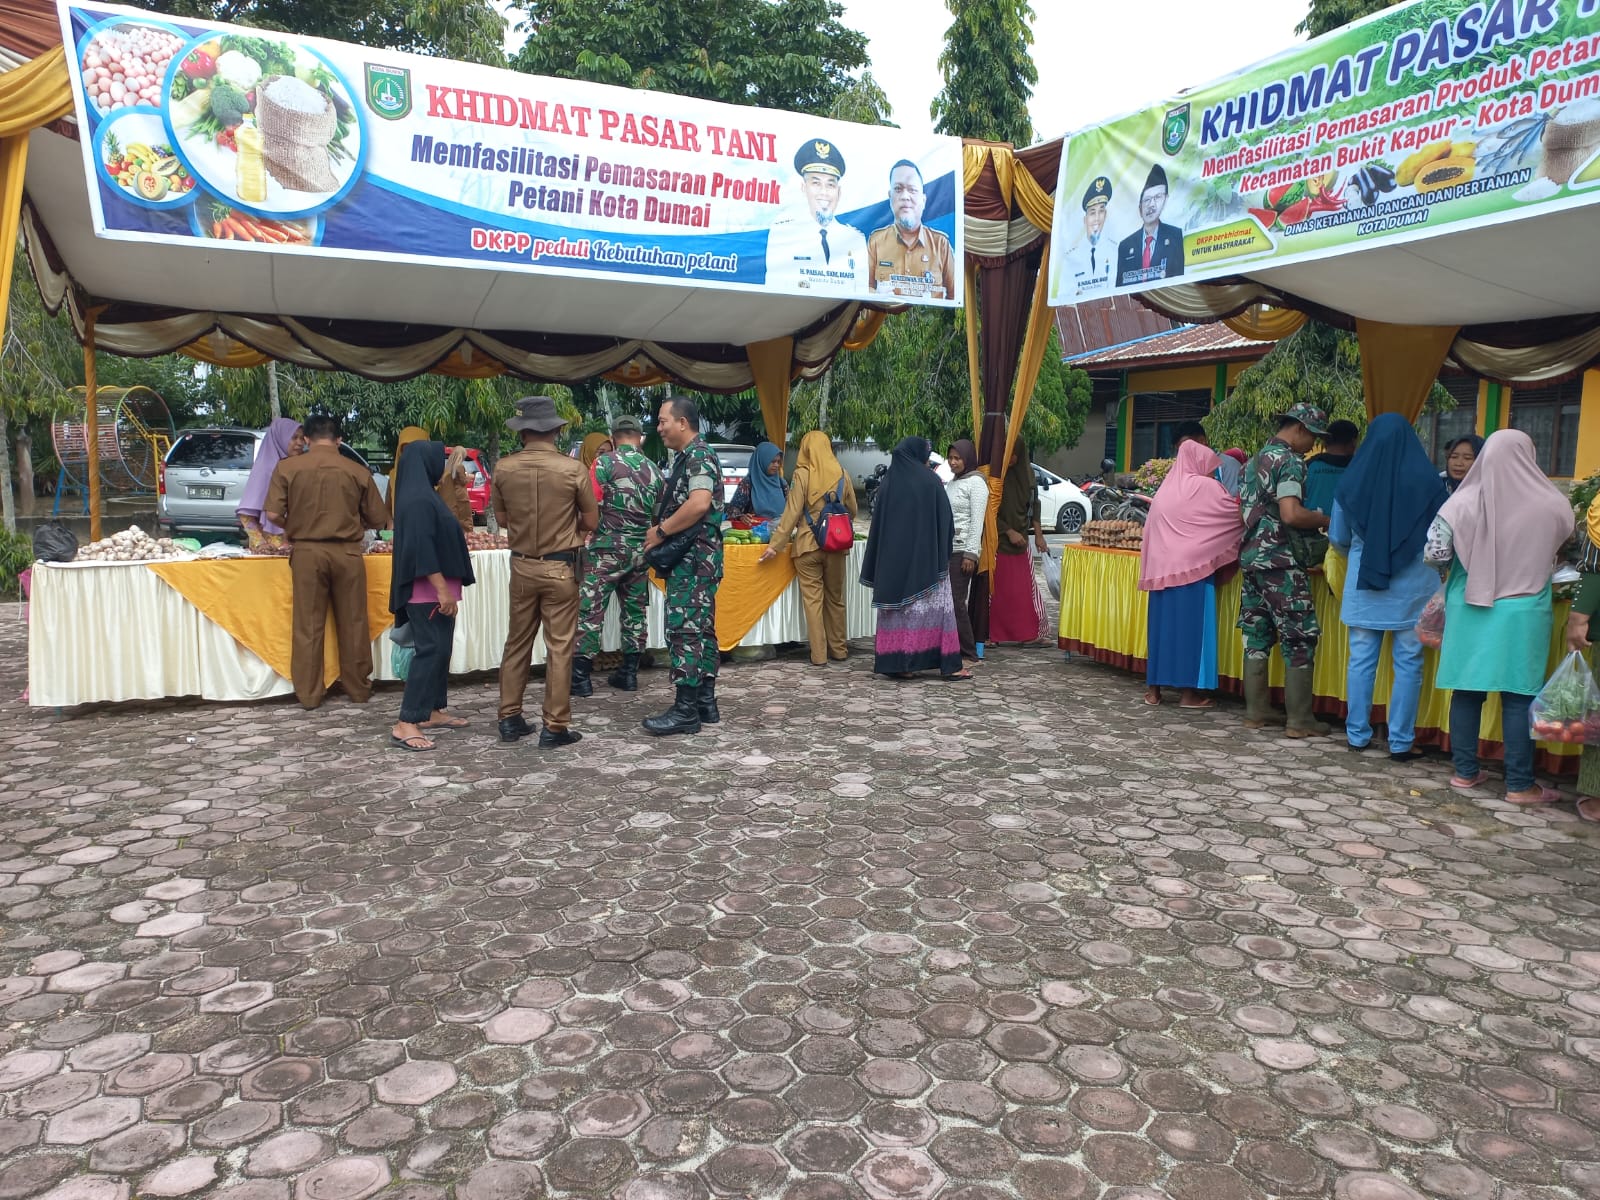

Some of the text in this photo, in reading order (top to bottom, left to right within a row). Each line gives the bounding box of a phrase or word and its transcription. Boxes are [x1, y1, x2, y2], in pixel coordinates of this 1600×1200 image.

[1201, 0, 1553, 145] KHIDMAT PASAR
[425, 84, 778, 162] KHIDMAT PASAR TANI
[1201, 127, 1311, 177] Memfasilitasi
[1315, 93, 1430, 143] Pemasaran
[1436, 59, 1523, 106] Produk
[1240, 155, 1332, 192] Kecamatan
[1337, 136, 1385, 167] Bukit
[1390, 119, 1456, 152] Kapur
[1478, 95, 1533, 126] Kota
[411, 134, 780, 205] Memfasilitasi Pemasaran Produk
[508, 180, 711, 227] Petani Kota Dumai
[1284, 168, 1531, 236] DINAS KETAHANAN PANGAN DAN PERTANIAN
[472, 229, 738, 272] DKPP peduli Kebutuhan petani
[1191, 237, 1256, 256] UNTUK MASYARAKAT
[1196, 227, 1252, 245] DKPP berkhidmat
[1357, 209, 1429, 235] KOTA DUMAI
